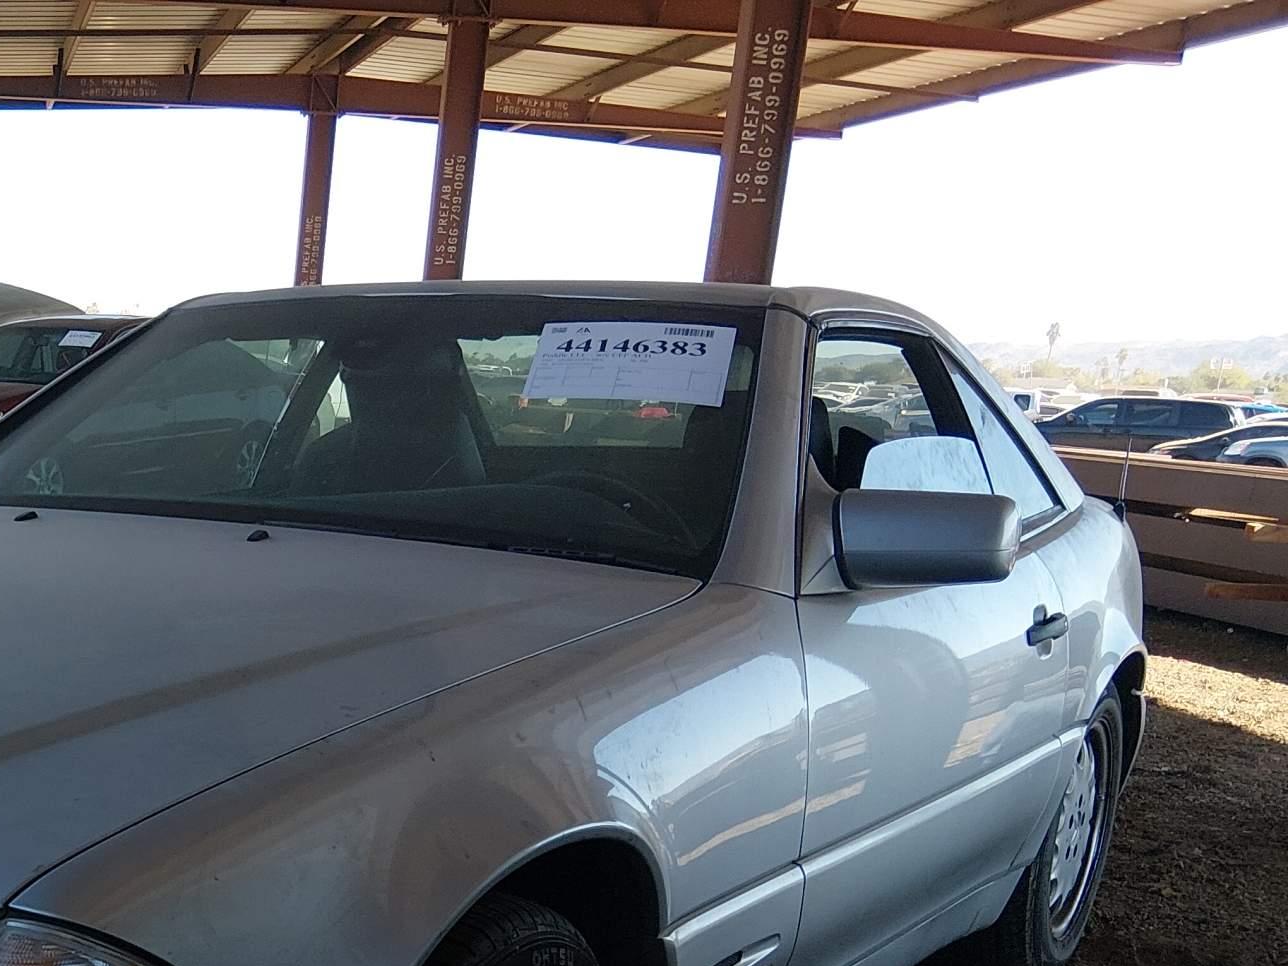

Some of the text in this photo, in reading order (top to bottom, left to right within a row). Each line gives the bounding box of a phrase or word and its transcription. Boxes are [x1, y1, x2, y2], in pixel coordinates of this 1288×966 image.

[732, 27, 772, 204] U.S. PREFAB INC.
[751, 29, 789, 203] 1-866-799-0969
[301, 237, 312, 273] PREFAB
[434, 154, 456, 265] U.S. PREFAB INC.
[445, 155, 466, 264] 1-866-799-0969
[556, 338, 707, 357] 44146383
